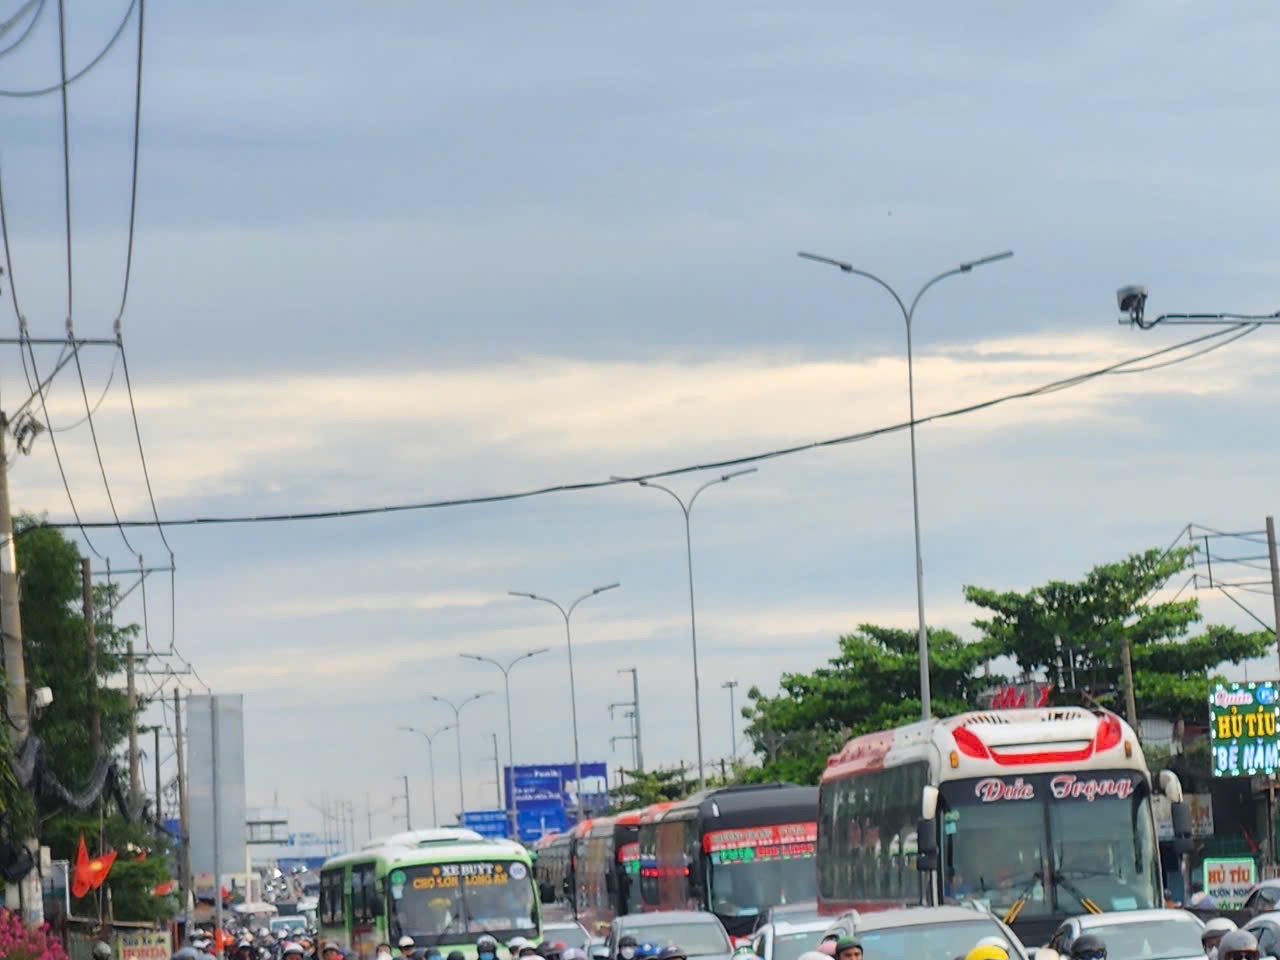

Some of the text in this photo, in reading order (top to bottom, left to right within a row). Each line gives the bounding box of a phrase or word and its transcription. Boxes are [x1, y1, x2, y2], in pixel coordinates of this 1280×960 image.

[1216, 705, 1277, 739] HỦ TÍU
[1243, 737, 1280, 770] NĂM
[1051, 774, 1134, 803] Trọng
[442, 864, 459, 876] XE
